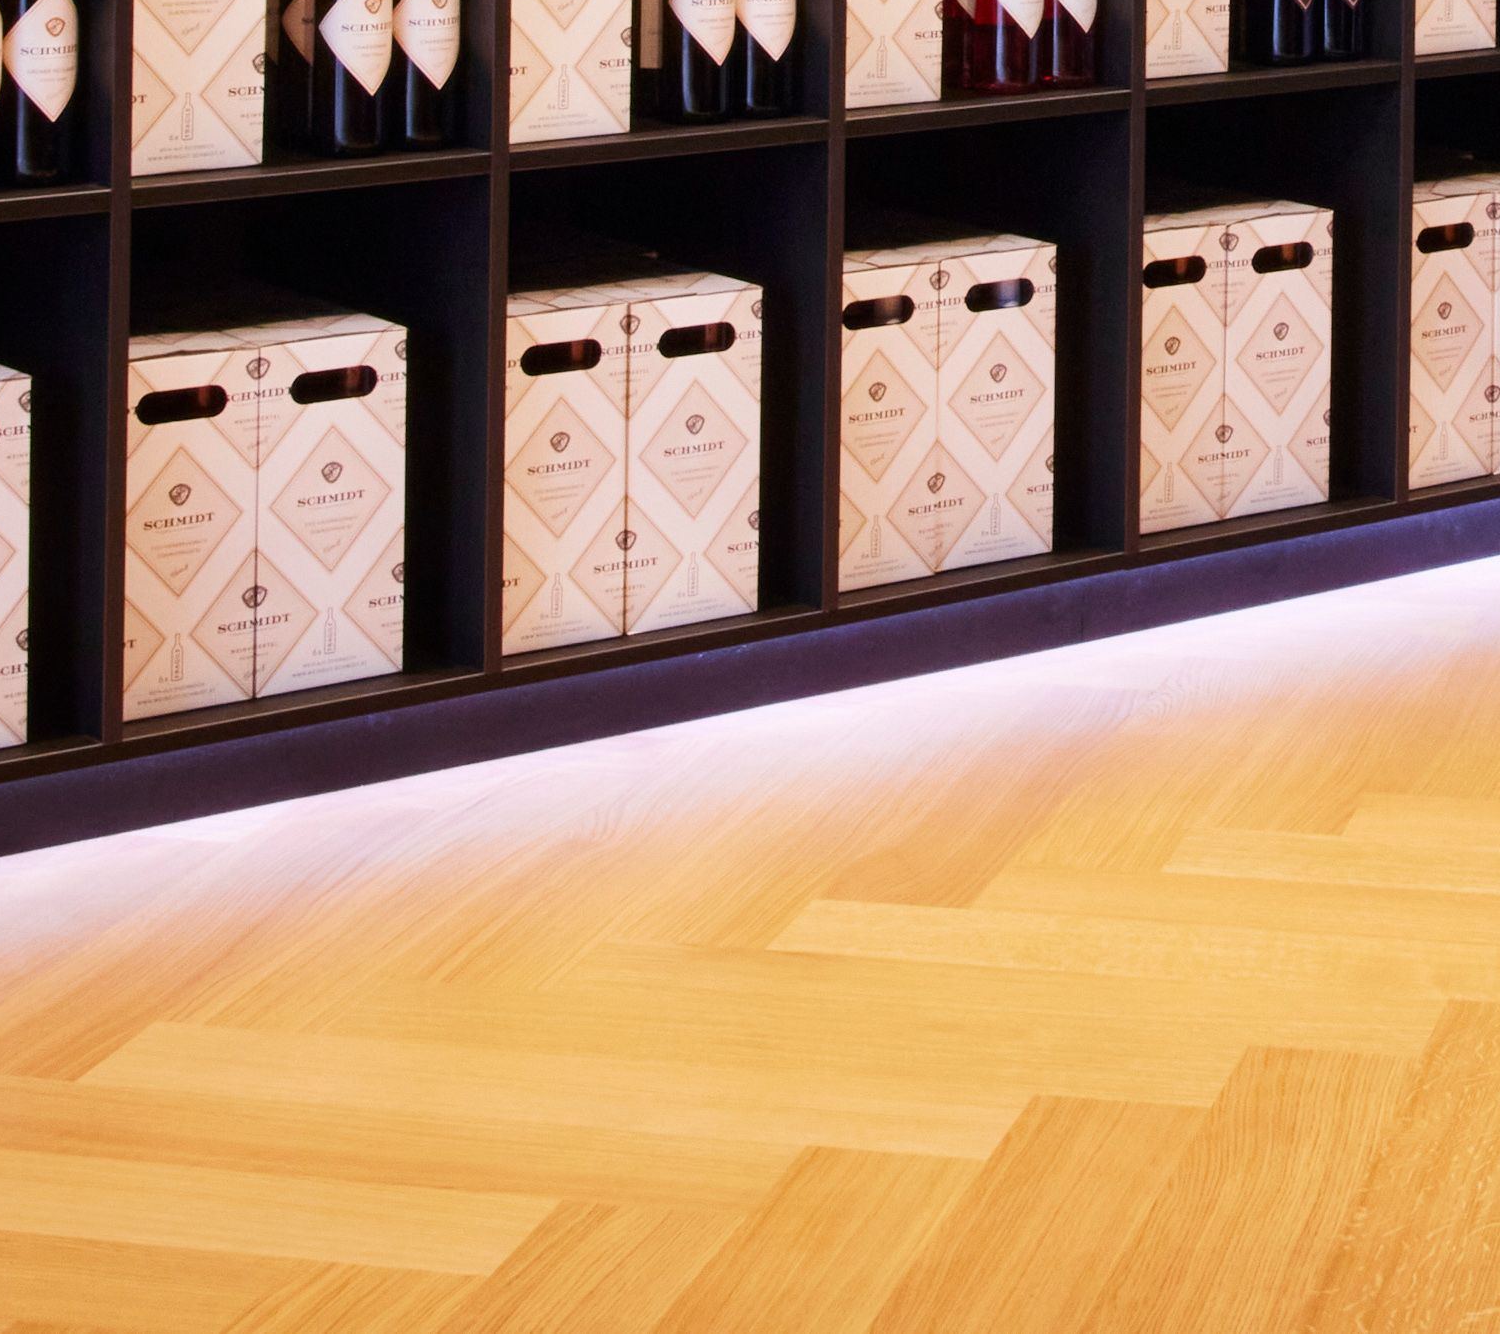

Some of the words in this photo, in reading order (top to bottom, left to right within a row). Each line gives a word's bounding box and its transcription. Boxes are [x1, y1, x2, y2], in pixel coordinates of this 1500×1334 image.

[1420, 324, 1468, 340] SCHMIDT
[1146, 361, 1197, 375] SCHMIDT
[848, 407, 905, 425] SCHMIDT
[526, 458, 592, 477] SCHMIDT
[142, 512, 214, 532] SCHMIDT
